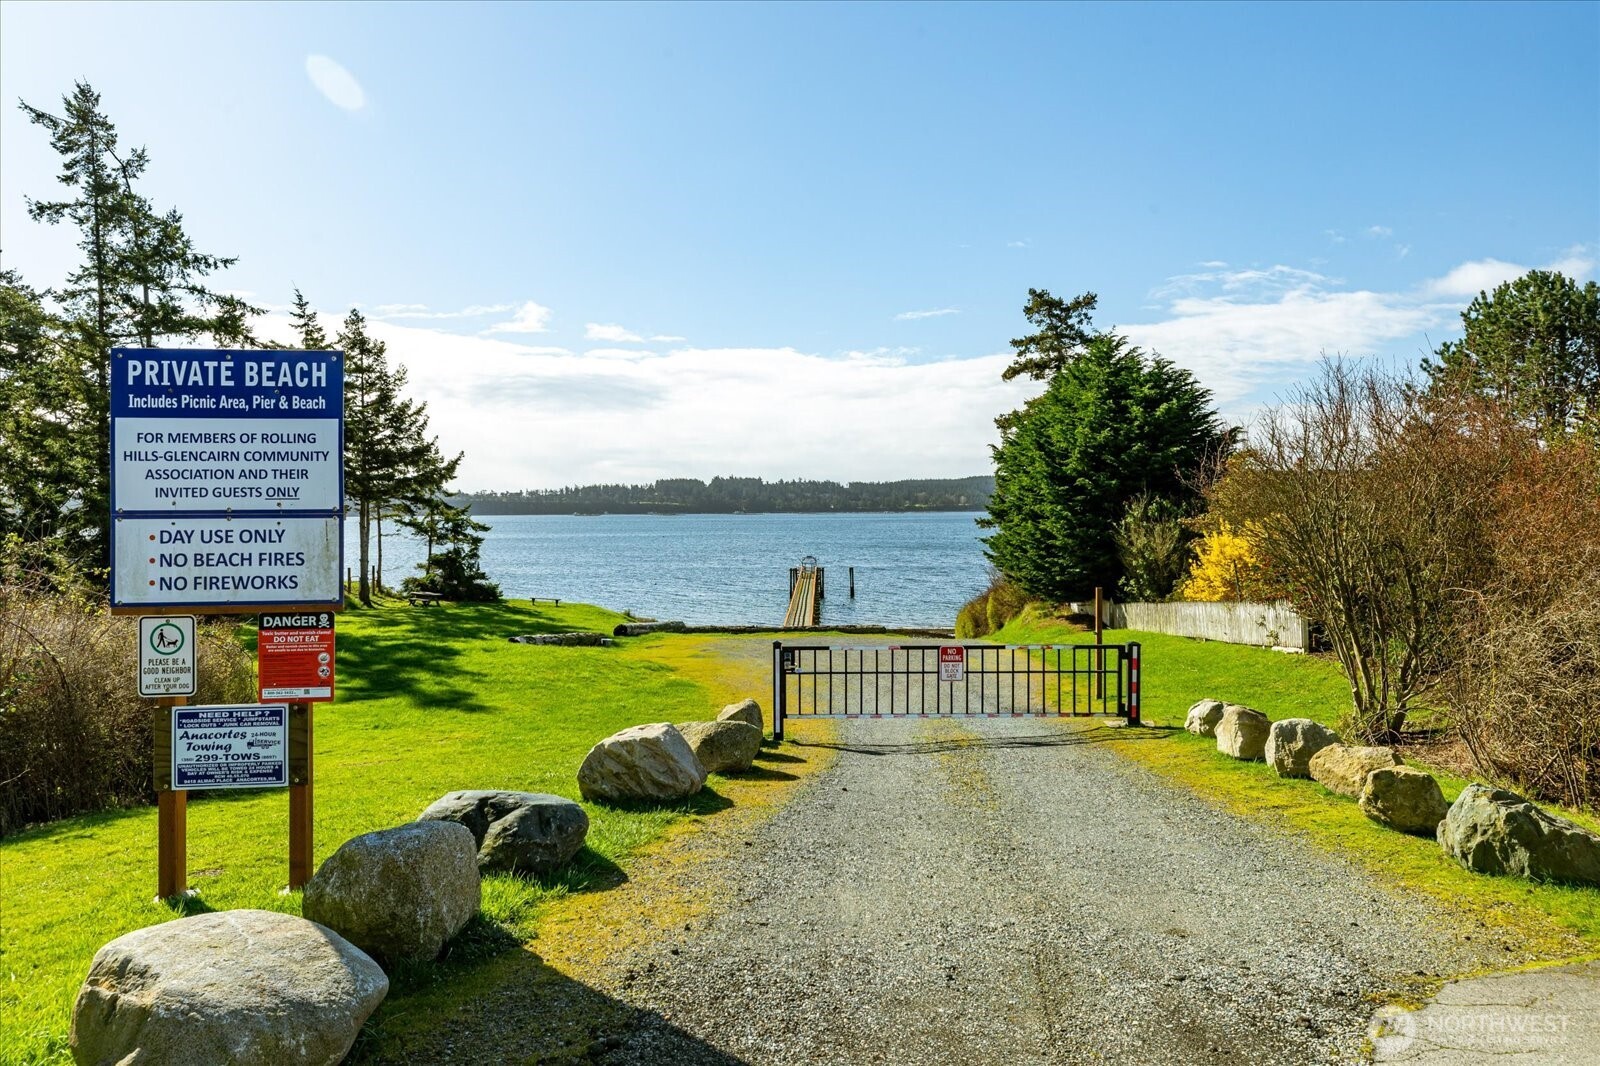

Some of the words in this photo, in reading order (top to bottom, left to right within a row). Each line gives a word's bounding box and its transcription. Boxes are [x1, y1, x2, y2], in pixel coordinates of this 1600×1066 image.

[127, 360, 235, 387] PRIVATE
[245, 361, 327, 387] BEACH
[128, 394, 178, 409] Includes
[181, 394, 216, 409] Picnic
[219, 395, 249, 412] Area,
[252, 395, 276, 409] Pier
[279, 396, 289, 409] &
[292, 395, 326, 409] Beach
[136, 432, 164, 444] FOR
[167, 432, 236, 444] MEMBERS
[239, 432, 258, 444] OF
[261, 432, 317, 444] ROLLING
[123, 450, 240, 462] HILLS-GLENCAIRN
[243, 450, 330, 462] COMMUNITY
[145, 468, 235, 480] ASSOCIATION
[238, 468, 268, 480] AND
[271, 468, 309, 480] THEIR
[155, 487, 209, 498] INVITED
[212, 487, 263, 498] GUESTS
[265, 486, 300, 500] ONLY
[159, 529, 195, 544] DAY
[200, 529, 234, 544] USE
[239, 529, 286, 544] ONLY
[159, 553, 188, 568] NO
[193, 552, 252, 567] BEACH
[258, 551, 305, 566] FIRES
[159, 576, 188, 591] NO
[193, 574, 299, 590] FIREWORKS
[263, 616, 317, 627] DANGER
[148, 658, 170, 666] PLEASE
[171, 658, 180, 666] BE
[143, 667, 159, 675] GOOD
[161, 666, 191, 674] NEIGHBOR
[179, 730, 247, 740] Anacortes
[186, 741, 232, 753] Towing
[195, 753, 260, 762] 299-TOWS
